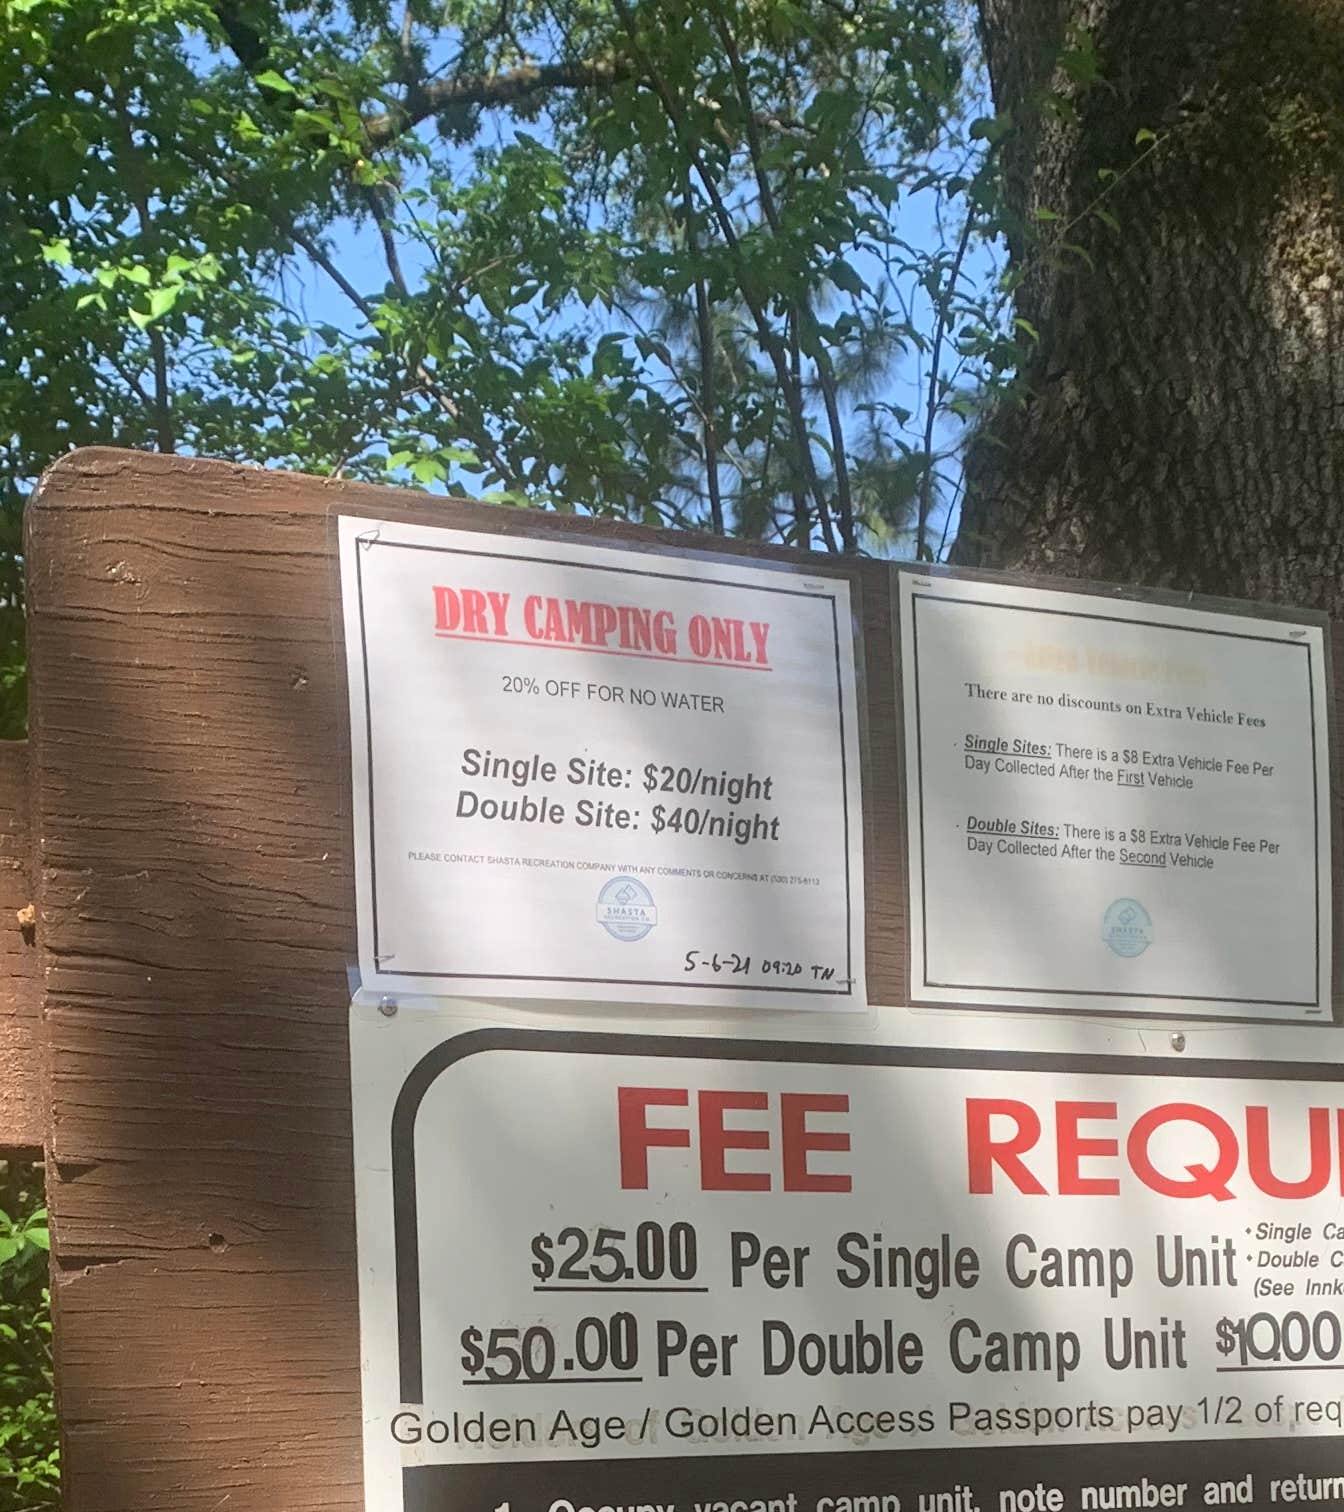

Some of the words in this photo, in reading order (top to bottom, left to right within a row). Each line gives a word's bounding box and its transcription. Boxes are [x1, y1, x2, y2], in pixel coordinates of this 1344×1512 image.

[433, 586, 509, 636] DRY
[524, 596, 676, 654] CAMPING
[689, 614, 768, 664] ONLY
[502, 676, 539, 694] 20%
[546, 680, 580, 698] OFF
[588, 684, 624, 703] FOR
[630, 688, 656, 706] NO
[661, 692, 724, 712] WATER
[964, 682, 1007, 700] There
[1012, 693, 1032, 703] are
[1038, 696, 1054, 705] no
[1058, 693, 1122, 712] discounts
[1126, 704, 1142, 714] on
[1146, 702, 1182, 718] Extra
[1186, 707, 1233, 724] Vehicle
[1238, 712, 1266, 727] Fees
[462, 749, 556, 786] Single
[567, 758, 631, 788] Site:
[643, 763, 772, 805] $20/night
[964, 734, 1010, 754] Single
[1012, 738, 1053, 758] Sites:
[1056, 743, 1092, 759] There
[1098, 750, 1107, 760] is
[1112, 752, 1118, 762] a
[1123, 750, 1138, 764] $8
[1143, 751, 1174, 767] Extra
[1178, 755, 1222, 772] Vehicle
[1227, 760, 1249, 774] Fee
[1253, 762, 1274, 776] Per
[965, 754, 990, 774] Day
[994, 758, 1054, 776] Collected
[1059, 764, 1090, 780] After
[1094, 768, 1113, 782] the
[1117, 769, 1144, 788] First
[1148, 772, 1193, 789] Vehicle
[456, 791, 564, 824] Double
[576, 800, 639, 830] Site:
[651, 804, 780, 845] $40/night
[618, 1087, 849, 1192] FEE
[1250, 1222, 1311, 1244] Single
[531, 1221, 698, 1283] $25.00
[731, 1232, 810, 1289] Per
[837, 1232, 980, 1299] Single
[1005, 1232, 1133, 1298] Camp
[1156, 1235, 1237, 1287] Unit
[461, 1312, 639, 1383] $50.00
[657, 1320, 738, 1378] Per
[763, 1320, 923, 1376] Double
[950, 1318, 1080, 1382] Camp
[1104, 1317, 1188, 1370] Unit
[391, 1411, 536, 1448] Golden
[549, 1410, 626, 1448] Age
[666, 1406, 796, 1438] Golden
[808, 1405, 934, 1434] Access
[950, 1401, 1113, 1436] Passports
[1128, 1405, 1183, 1434] pay
[1198, 1396, 1242, 1424] 1/2
[1255, 1395, 1284, 1426] of
[1000, 1484, 1063, 1512] note
[1082, 1478, 1187, 1509] number
[1204, 1474, 1252, 1504] and
